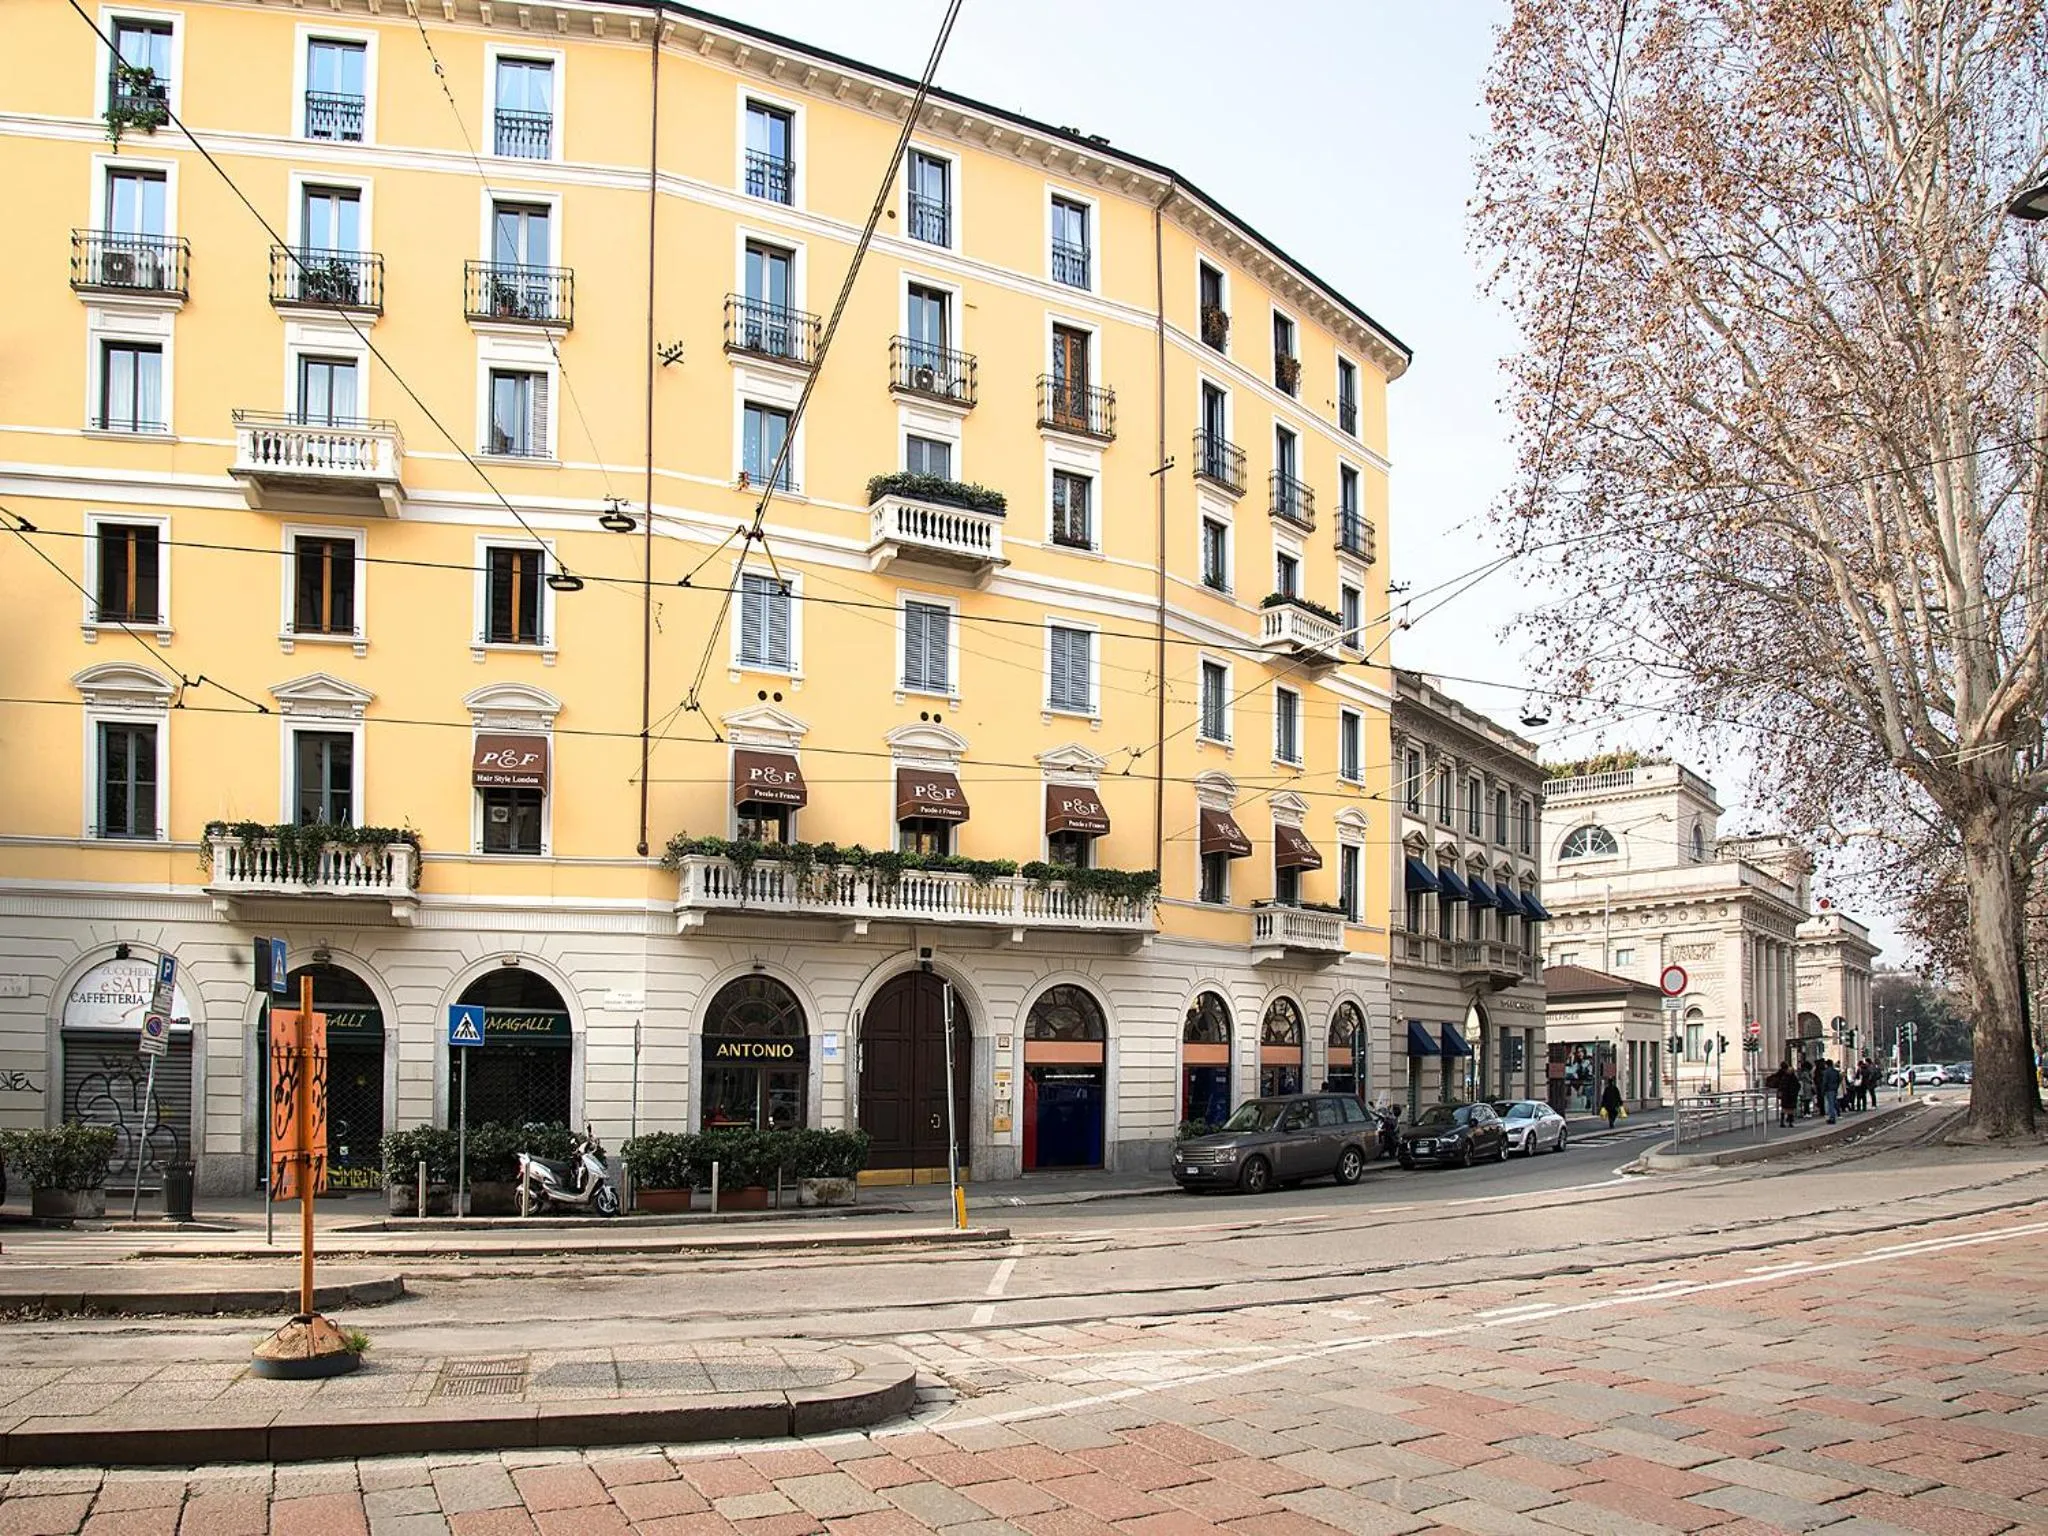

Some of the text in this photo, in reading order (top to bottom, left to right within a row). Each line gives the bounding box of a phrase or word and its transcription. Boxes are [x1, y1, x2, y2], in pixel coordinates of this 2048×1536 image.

[477, 774, 539, 784] Hair Style London
[102, 967, 155, 977] ZUCCHER
[163, 962, 172, 978] P
[70, 991, 145, 1005] CAFFETTERIA
[716, 1043, 794, 1058] ANTONIO
